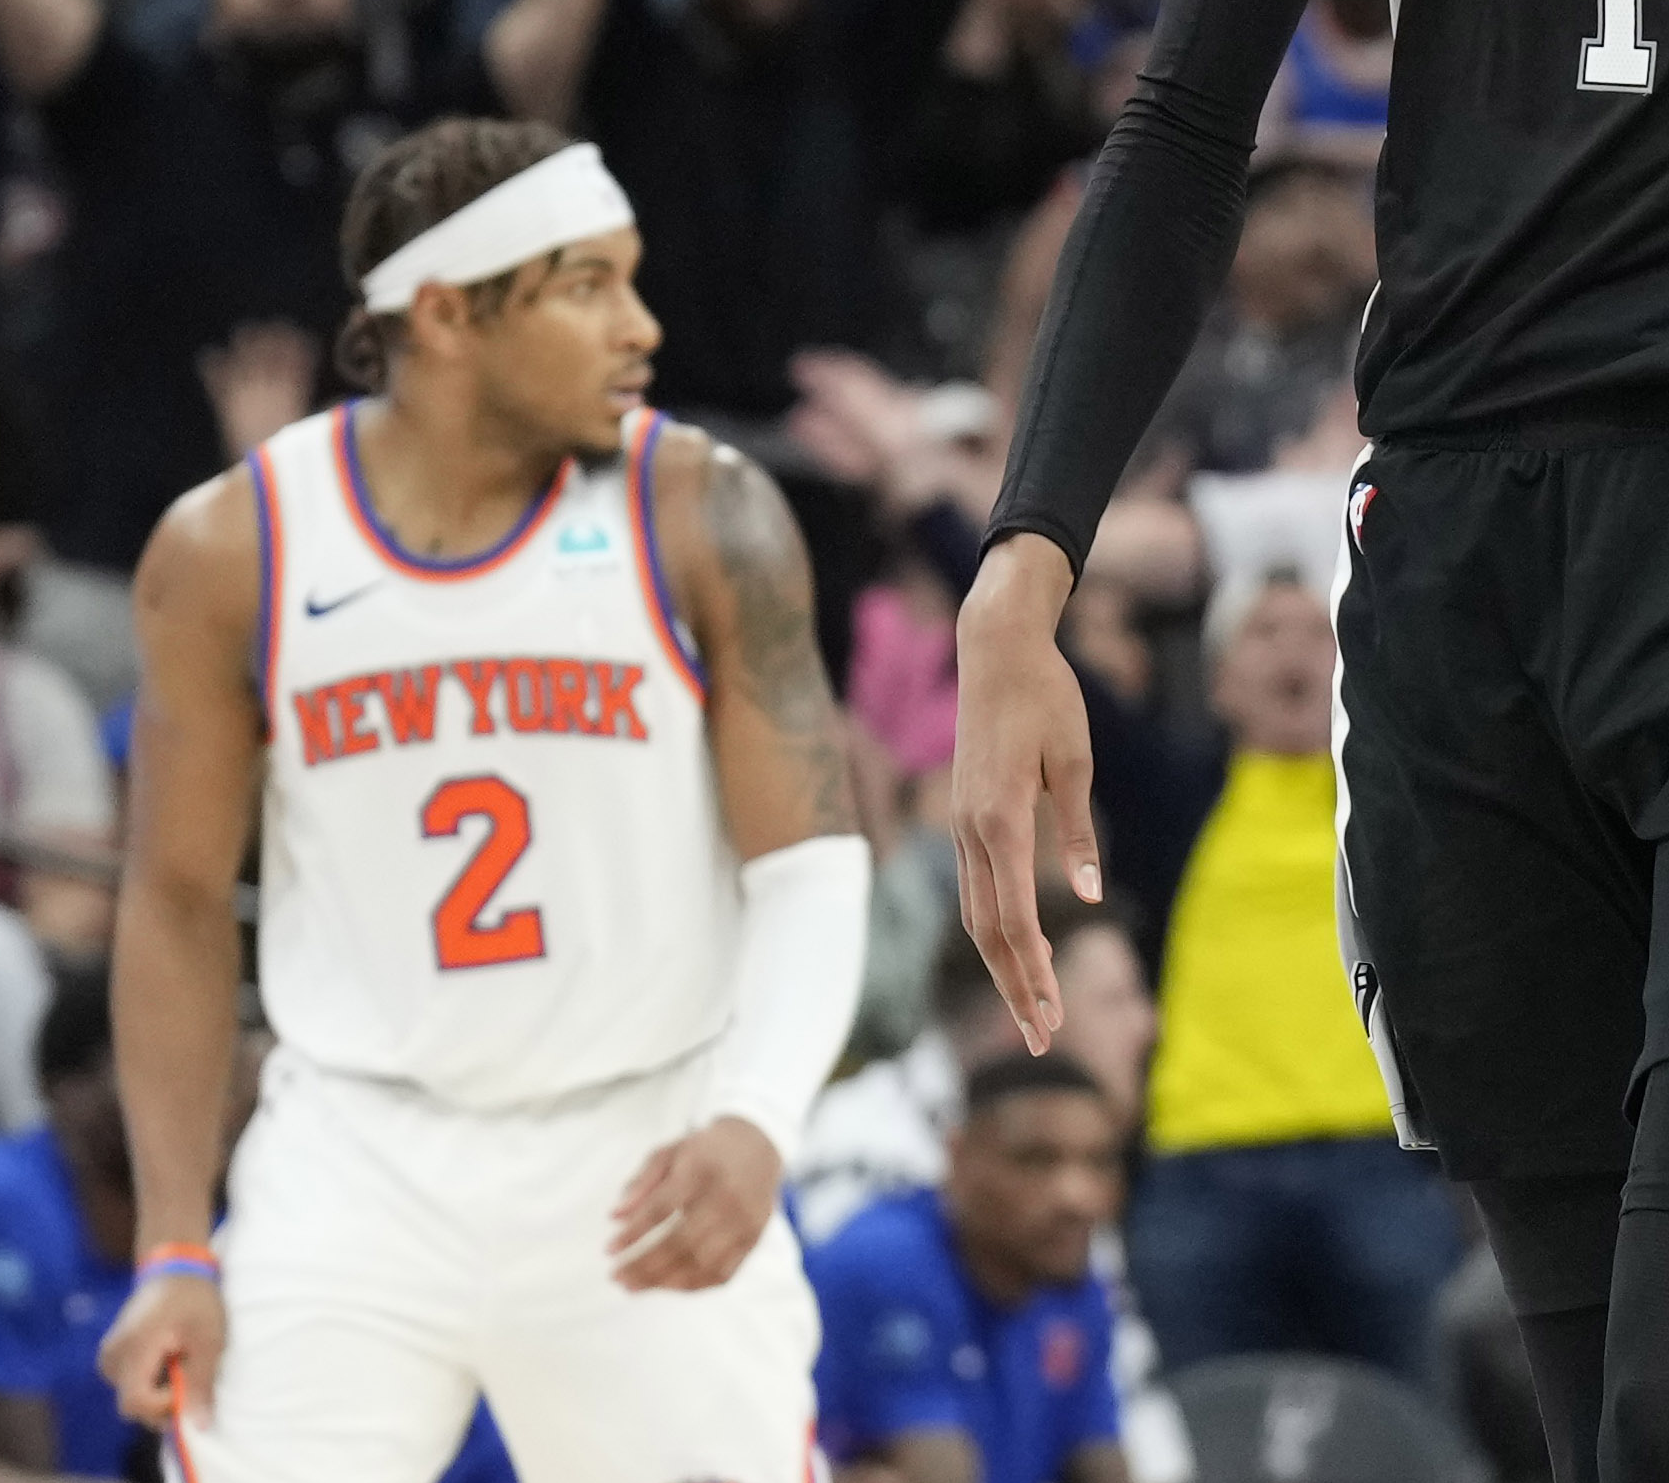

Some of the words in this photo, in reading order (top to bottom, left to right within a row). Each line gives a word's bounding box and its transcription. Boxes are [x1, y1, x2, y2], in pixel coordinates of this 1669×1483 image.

[293, 664, 441, 767] NEW
[450, 657, 649, 742] YORK
[420, 775, 547, 972] 2
